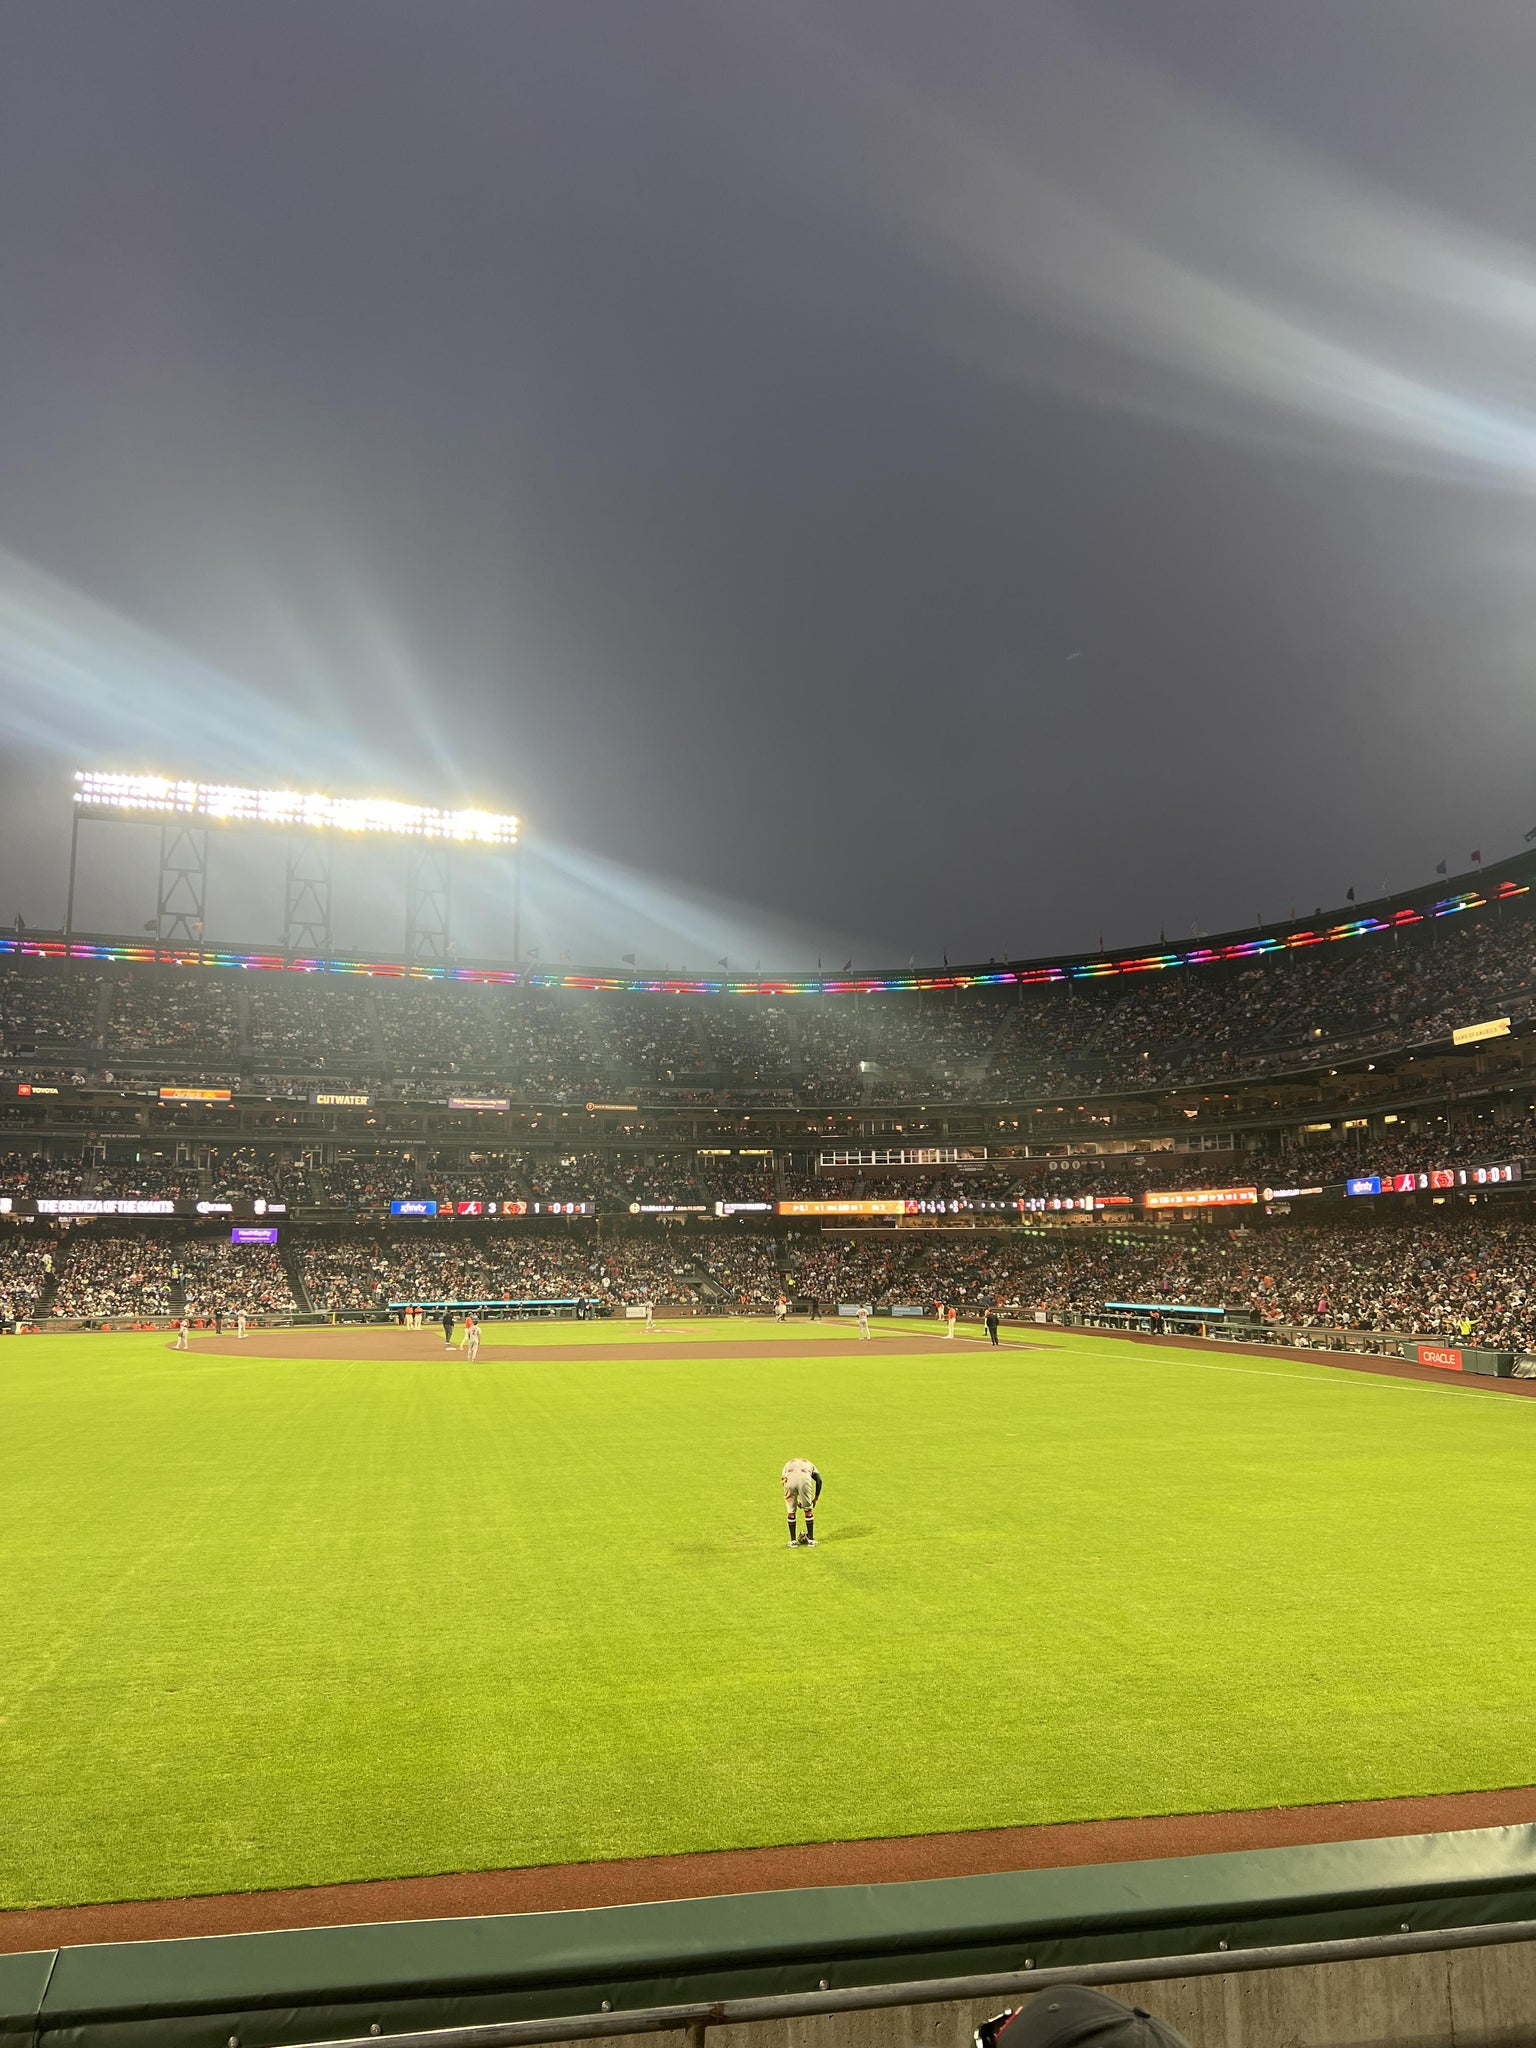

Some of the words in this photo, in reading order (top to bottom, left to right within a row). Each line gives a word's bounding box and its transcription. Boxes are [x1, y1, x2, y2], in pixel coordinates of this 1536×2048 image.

[317, 1095, 369, 1105] CUTWATER
[1419, 1173, 1428, 1188] 3
[1460, 1170, 1467, 1184] 1
[1478, 1168, 1487, 1183] 0
[1491, 1167, 1500, 1182] 0
[1505, 1166, 1512, 1181] 1
[37, 1200, 58, 1213] THE
[59, 1200, 102, 1213] CERVEZA
[103, 1200, 118, 1213] OF
[118, 1200, 137, 1213] THE
[137, 1201, 175, 1213] GIANTS
[400, 1203, 427, 1213] xfinity
[488, 1202, 497, 1213] 3
[534, 1202, 540, 1213] 1
[553, 1202, 561, 1213] 0
[566, 1202, 574, 1213] 0
[581, 1203, 586, 1213] 1
[1423, 1351, 1456, 1365] ORACLE
